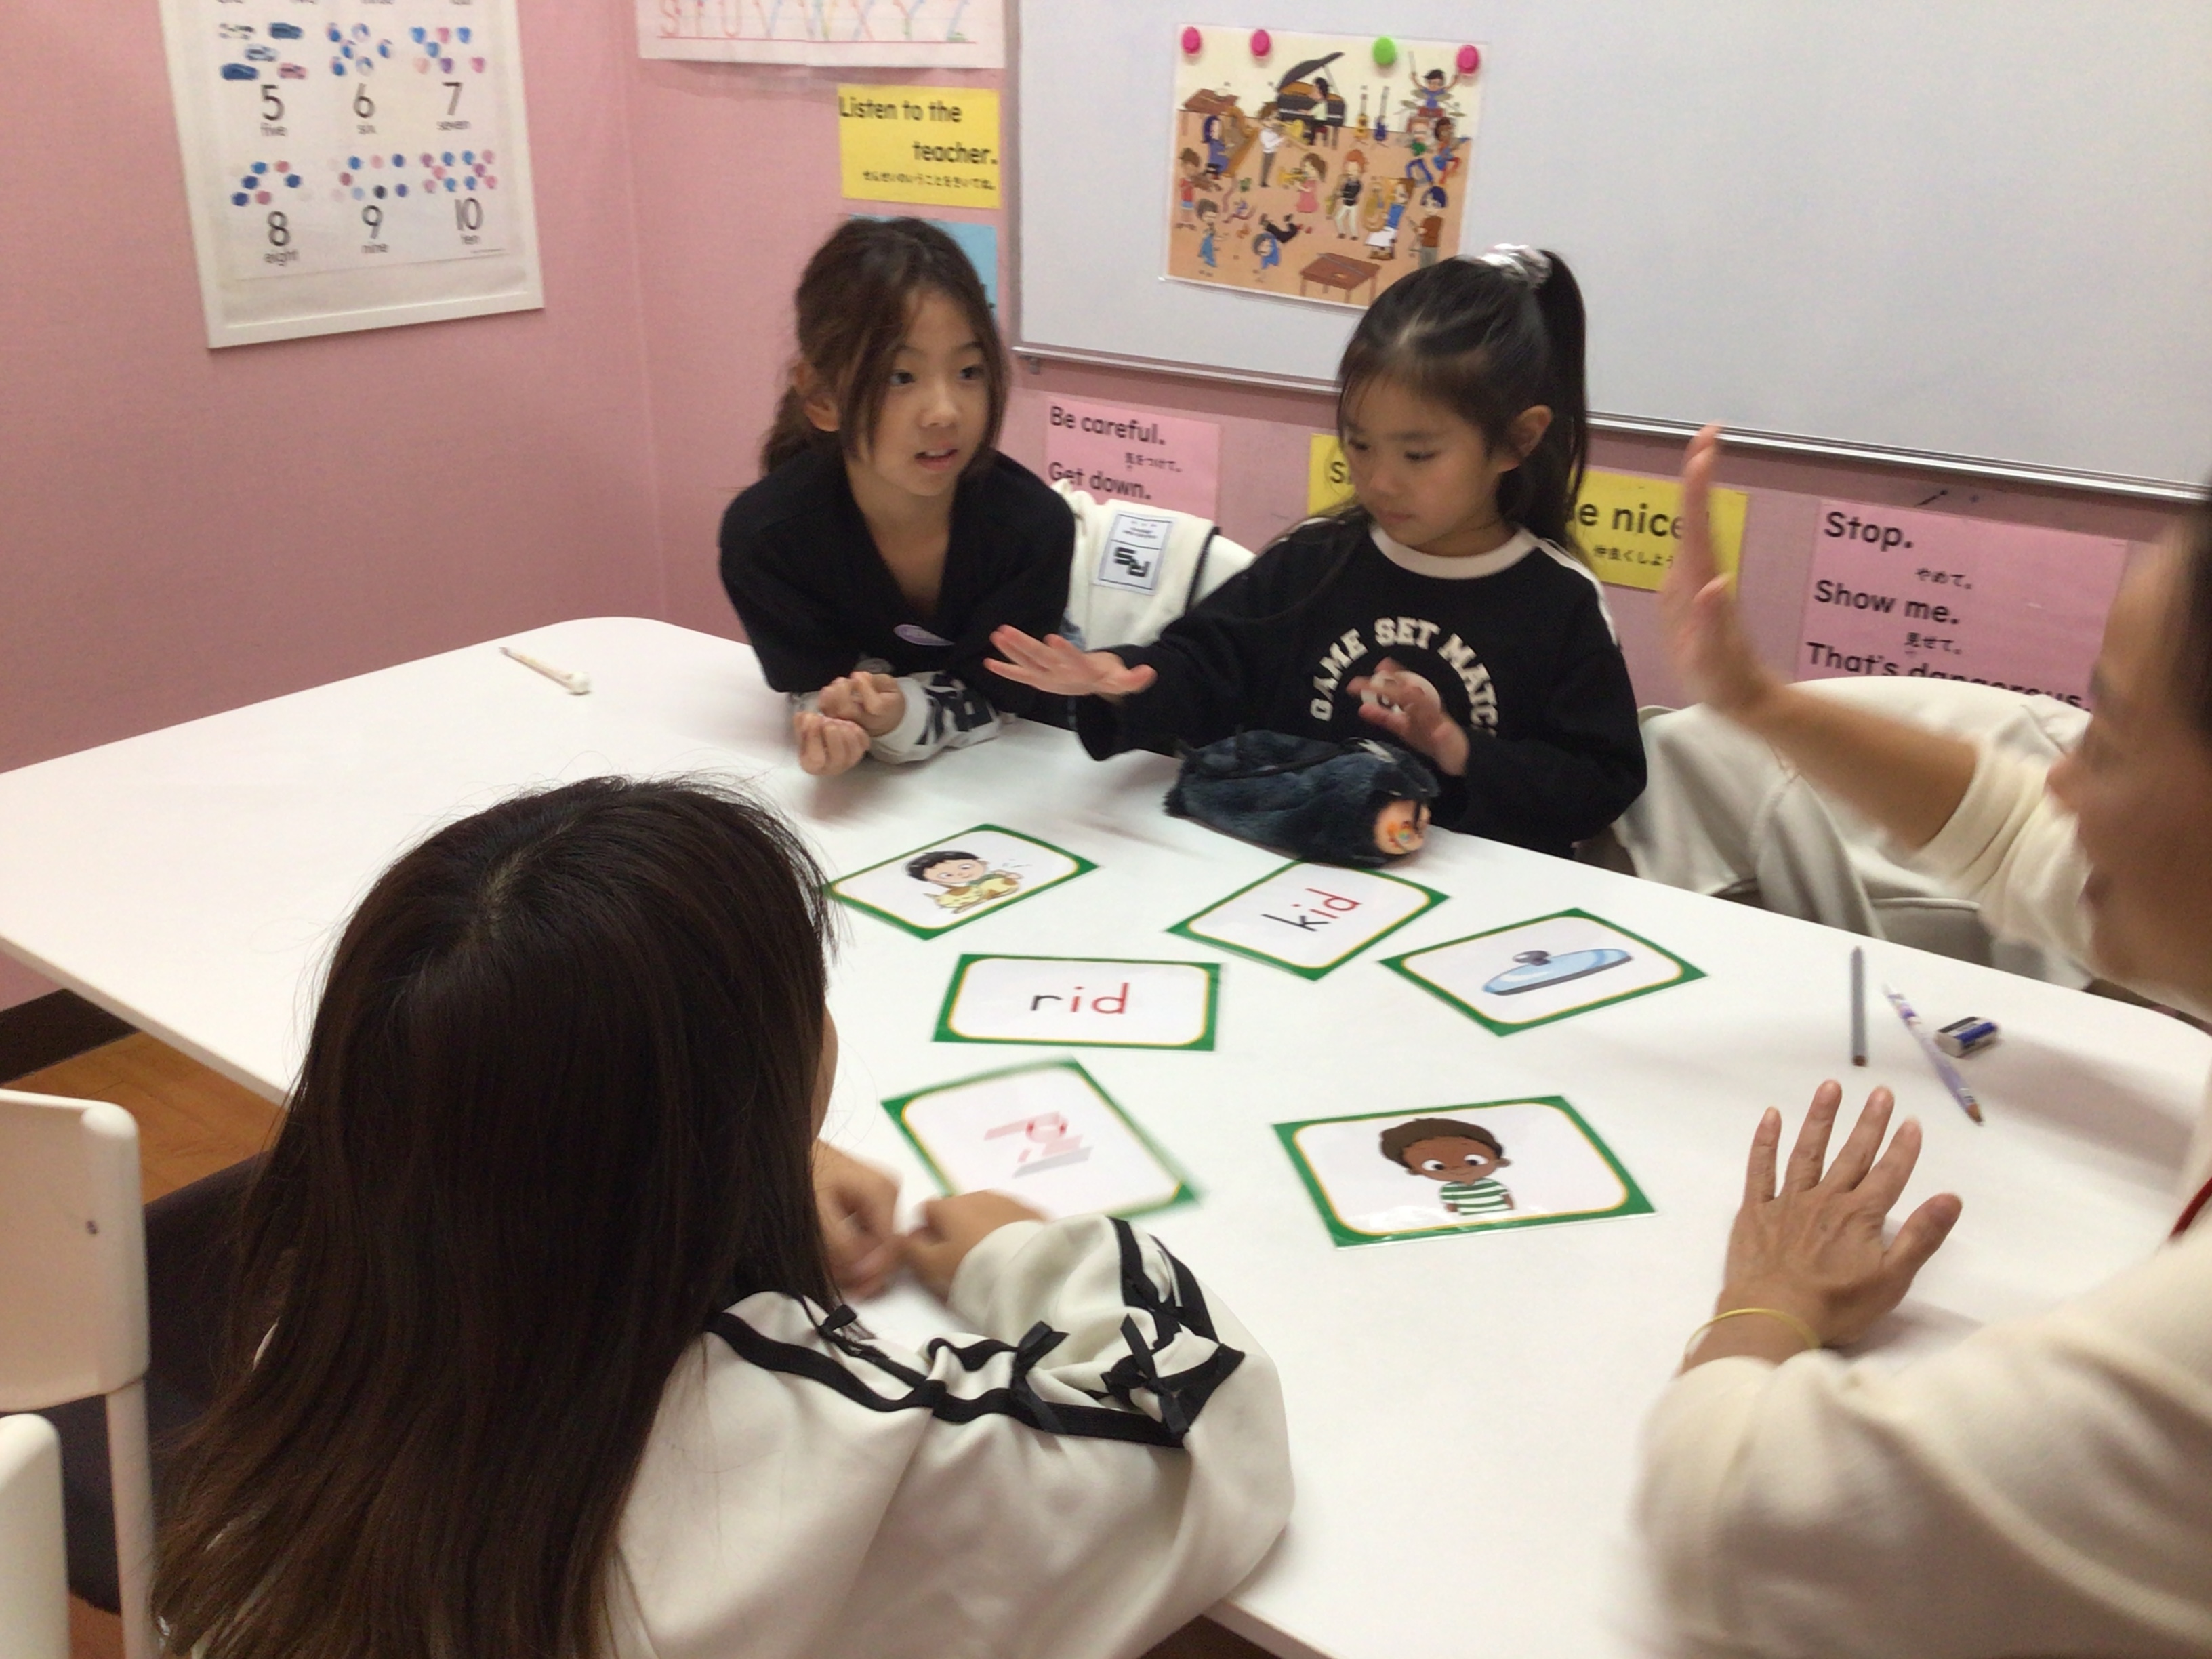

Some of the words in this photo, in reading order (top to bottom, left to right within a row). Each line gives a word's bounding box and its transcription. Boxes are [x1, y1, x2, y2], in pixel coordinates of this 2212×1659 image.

[260, 84, 285, 120] 5
[353, 83, 375, 118] 6
[442, 82, 462, 115] 7
[838, 96, 897, 120] Listen
[902, 100, 924, 121] to
[928, 100, 962, 122] the
[912, 141, 998, 164] teacher.
[267, 211, 290, 246] 8
[361, 205, 382, 238] 9
[455, 198, 483, 230] 10
[1050, 406, 1076, 428] Be
[1081, 418, 1166, 445] careful.
[1048, 462, 1085, 486] Get
[1089, 470, 1151, 500] down.
[1824, 511, 1914, 552] Stop.
[1814, 579, 1897, 613] Show
[1904, 600, 1960, 625] me.
[1374, 616, 1441, 651] SET
[1437, 632, 1499, 737] MATC
[1806, 641, 1900, 676] That's
[1261, 887, 1362, 932] kid
[1030, 982, 1130, 1015] rid
